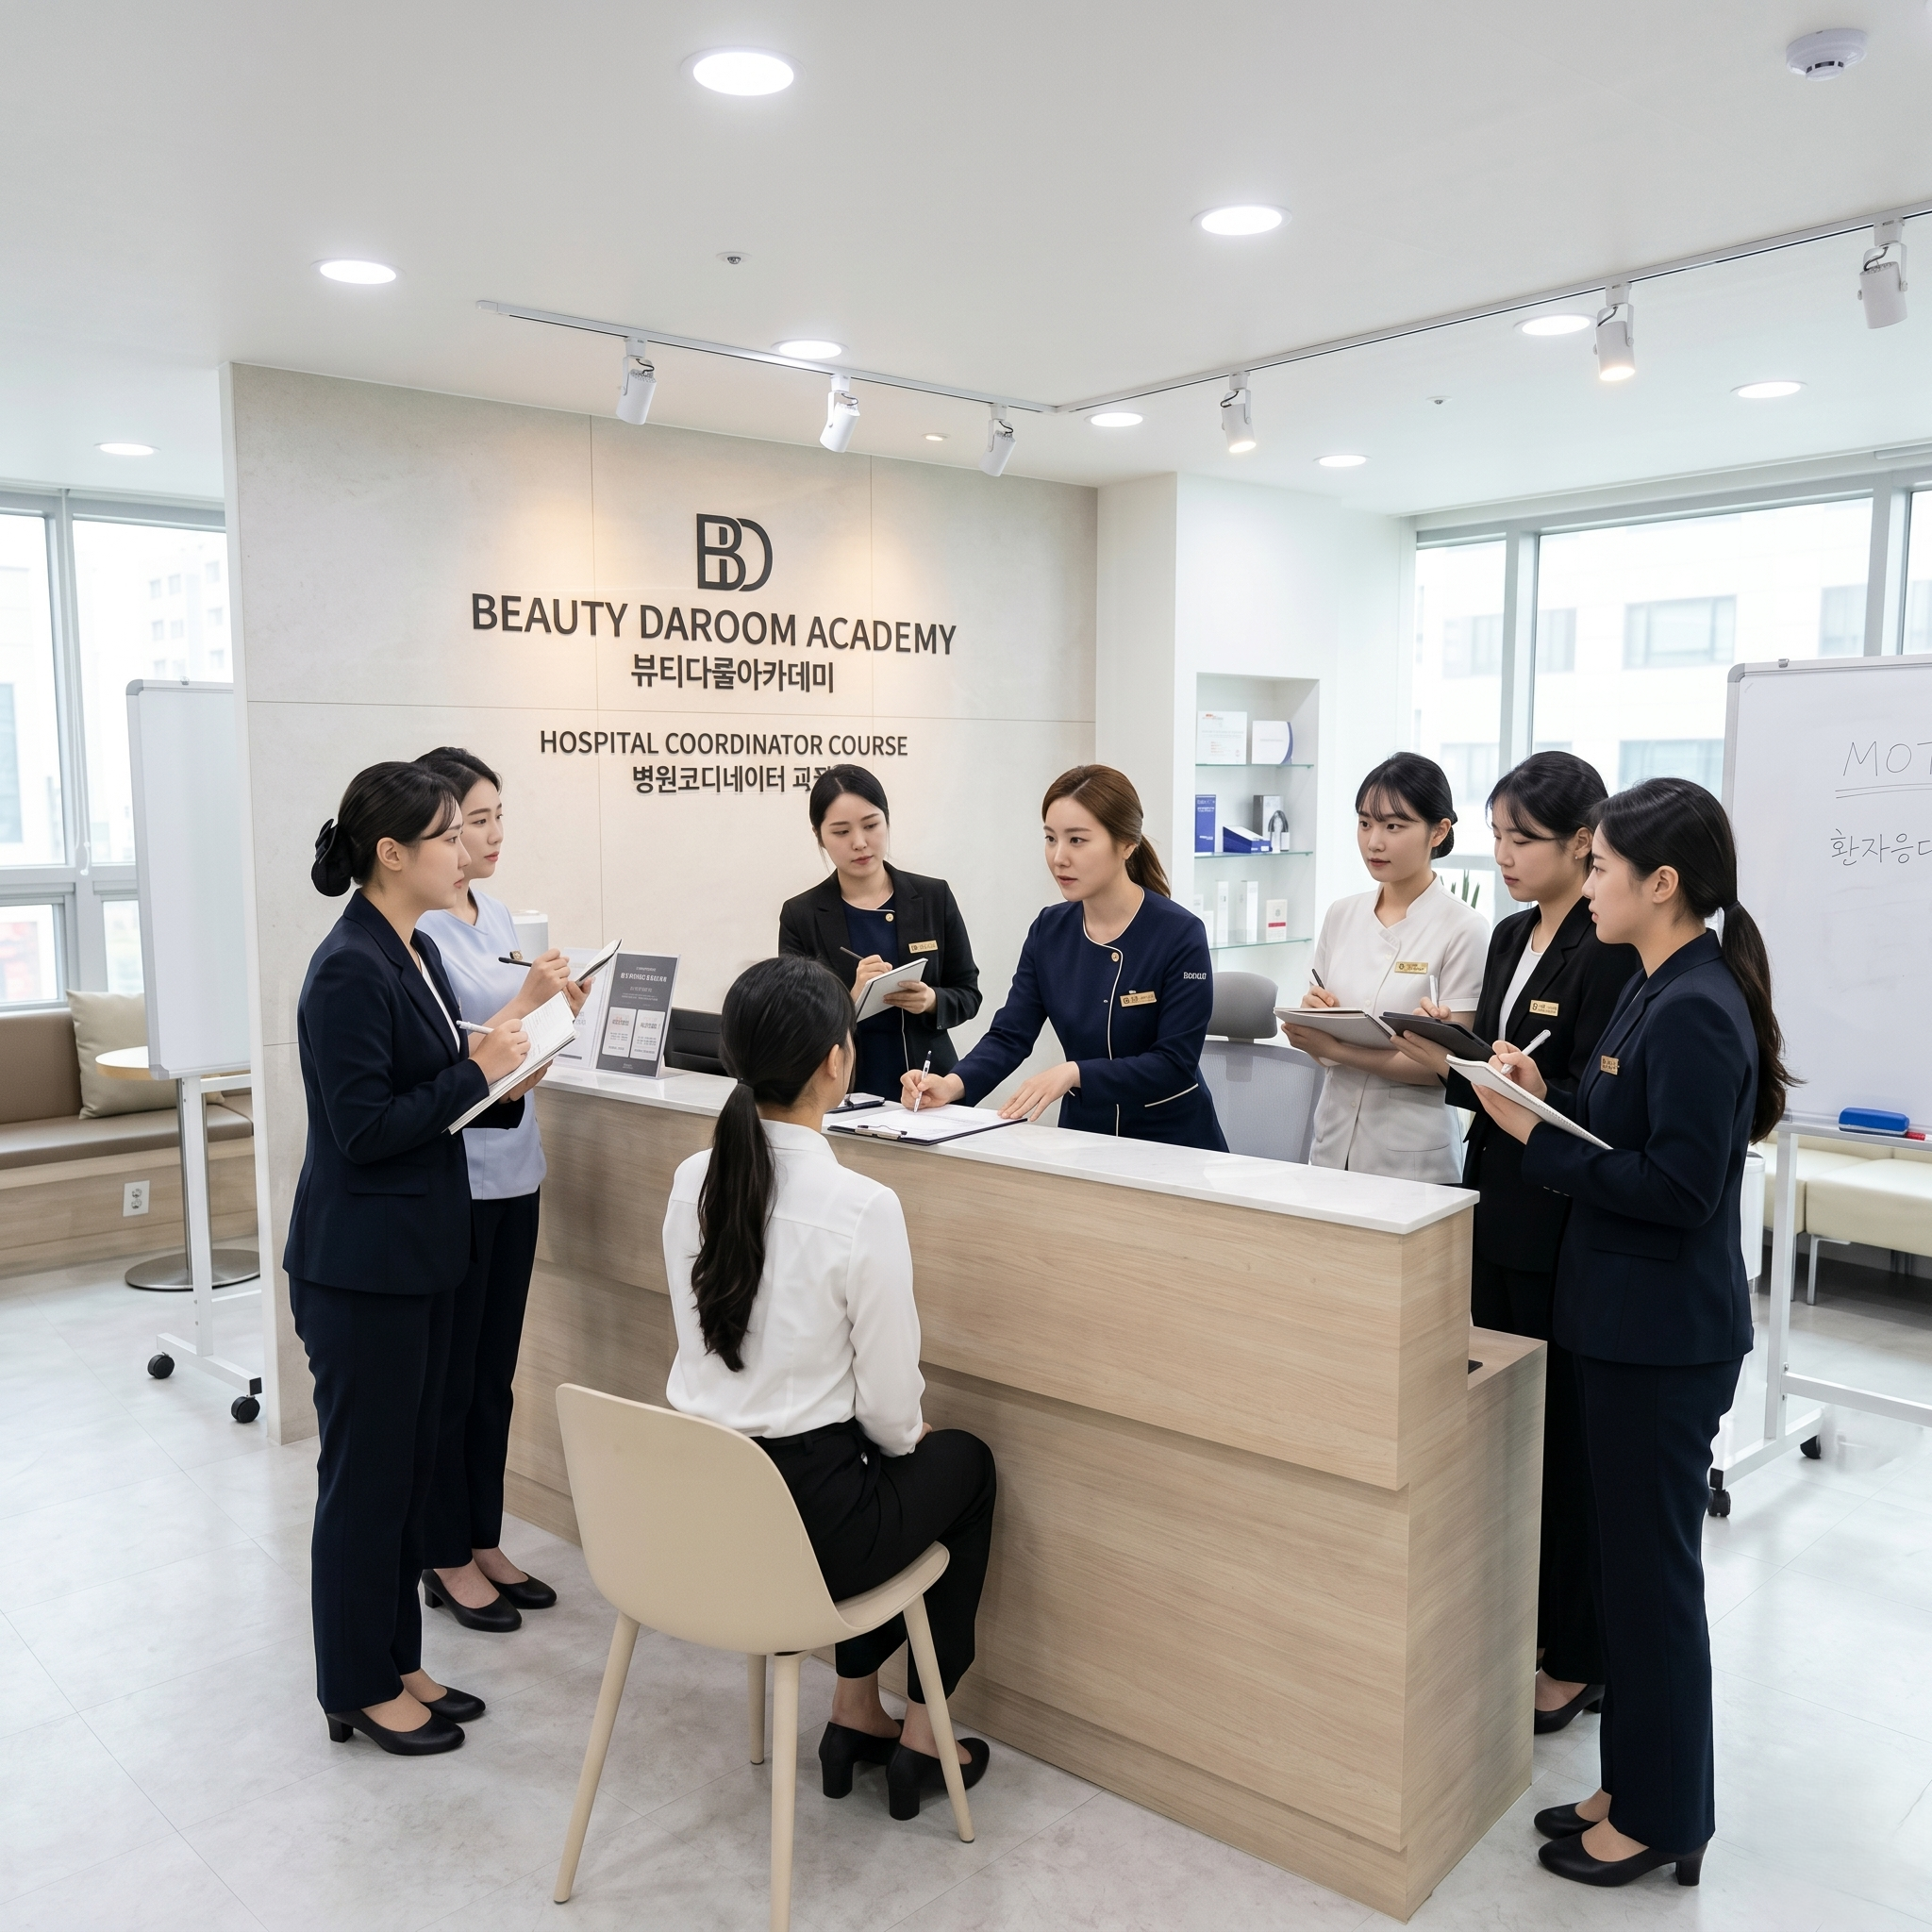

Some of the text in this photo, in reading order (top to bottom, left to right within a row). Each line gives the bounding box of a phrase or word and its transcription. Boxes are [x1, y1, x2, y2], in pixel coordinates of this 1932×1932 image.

[472, 592, 957, 656] BEAUTY DAROOM ACADEMY
[540, 730, 908, 757] HOSPITAL COORDINATOR COURSE
[632, 765, 785, 794] 병원코디네이터
